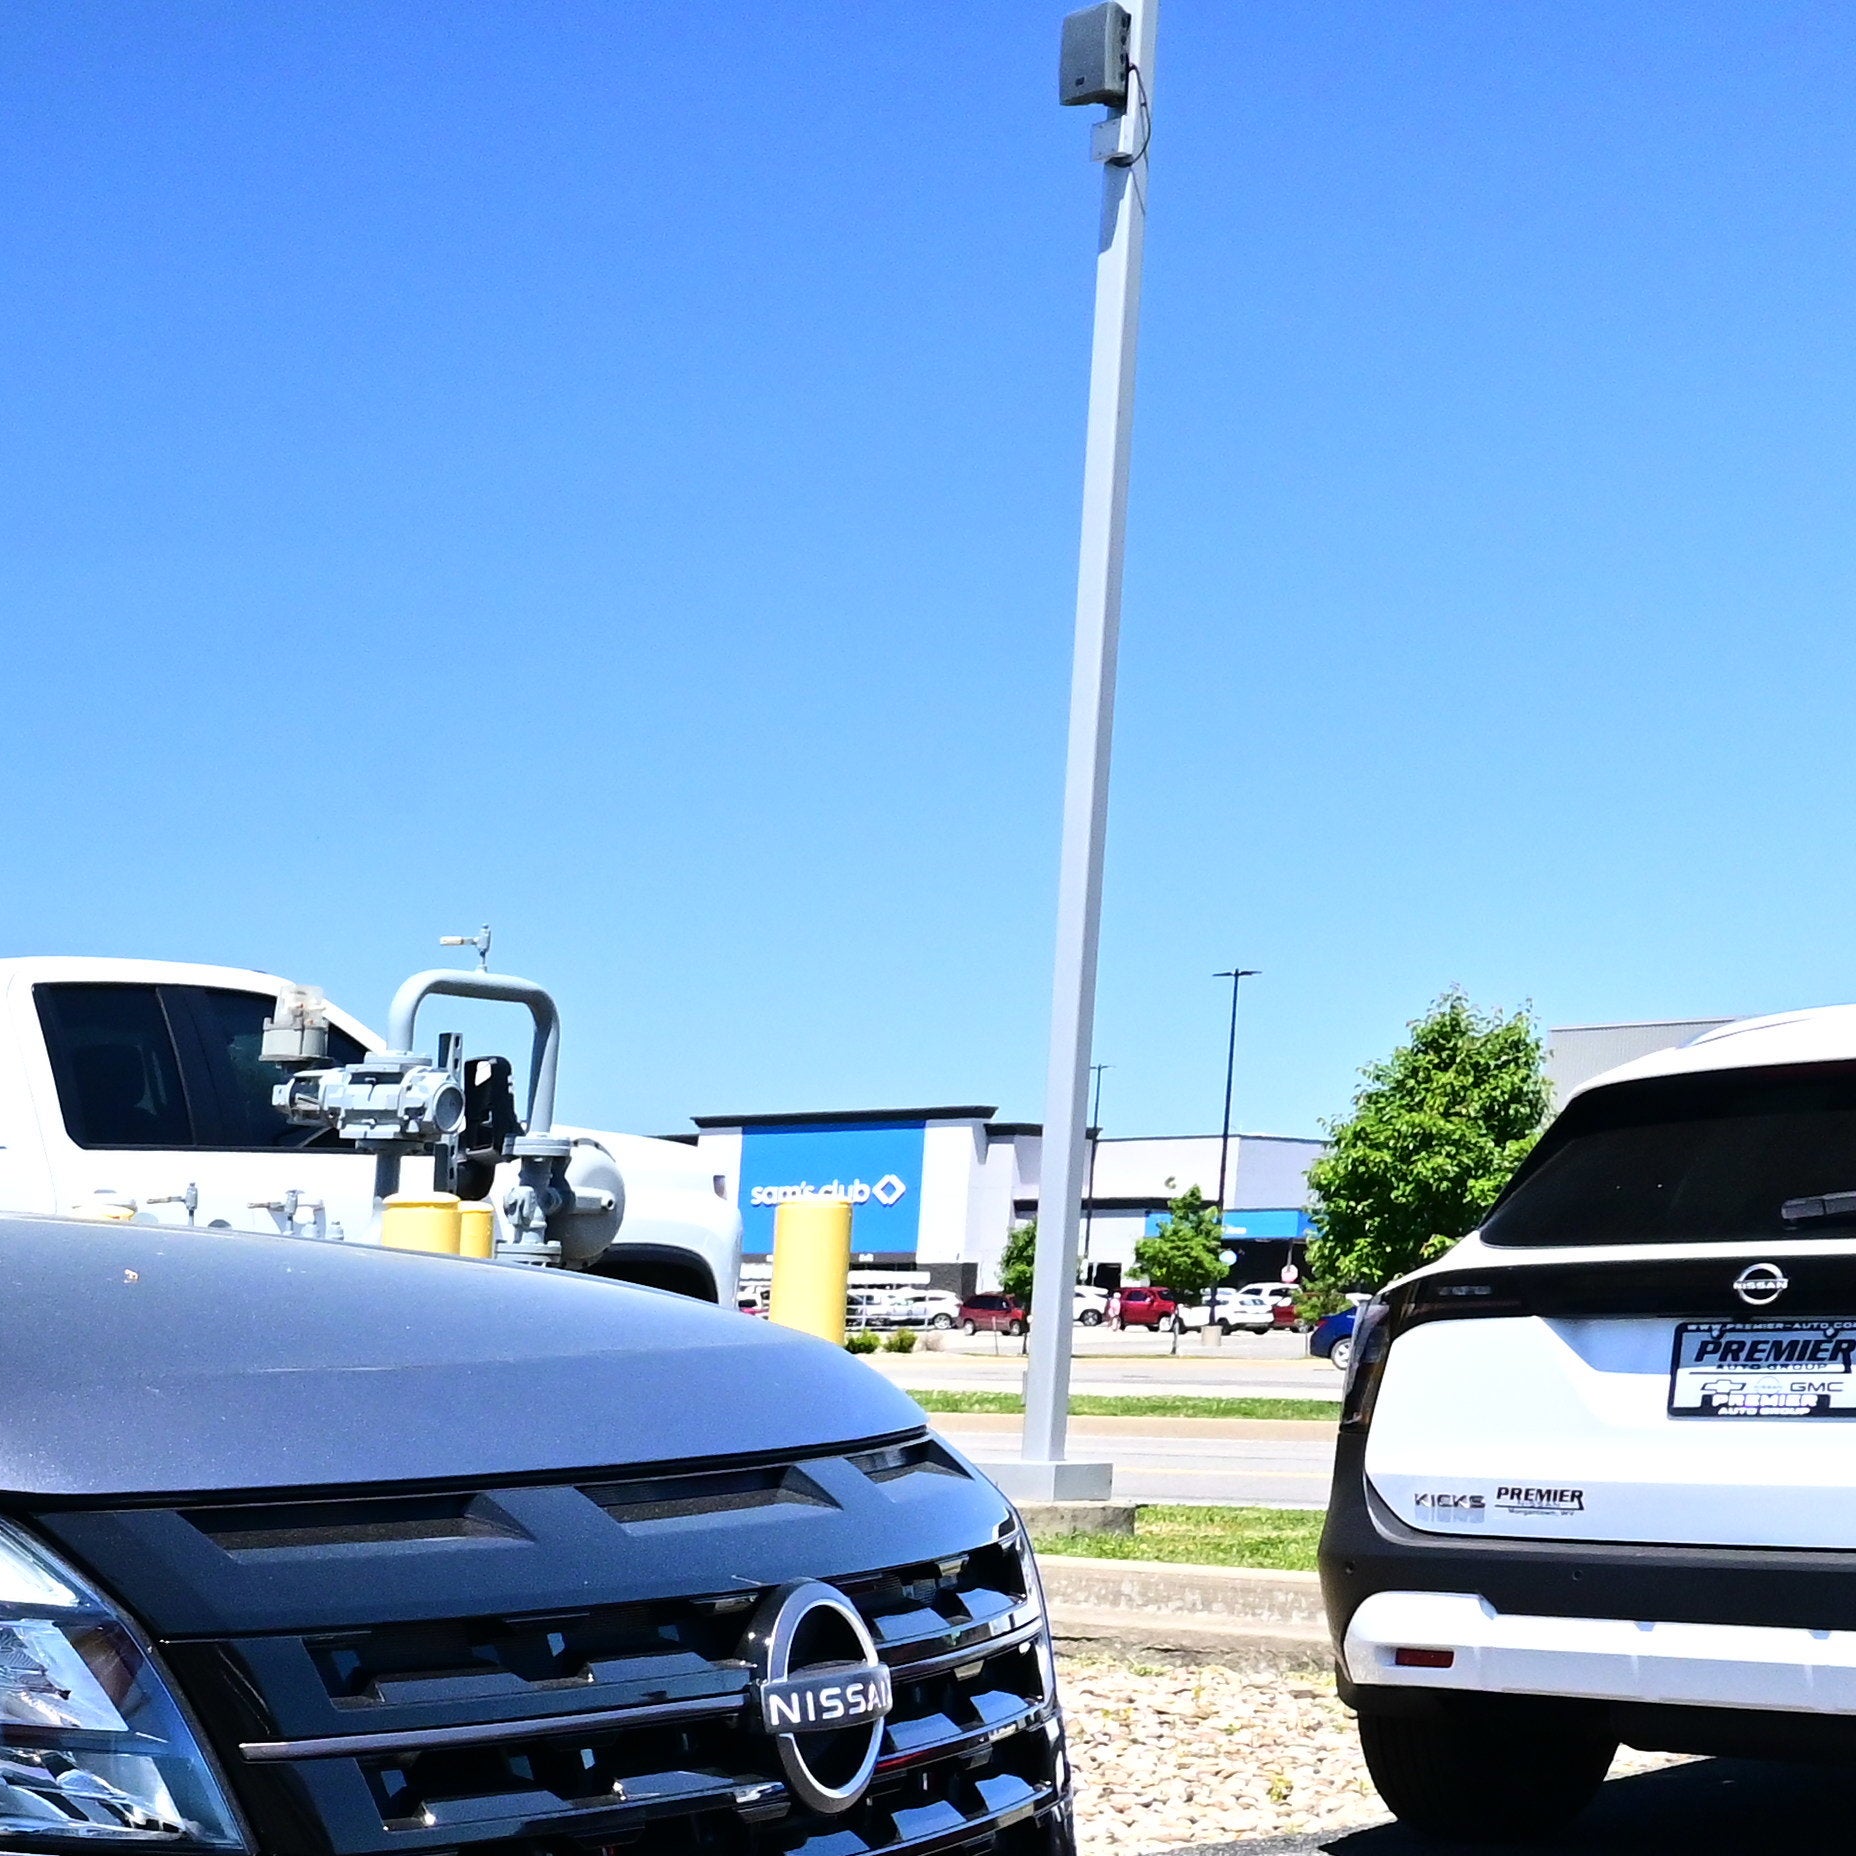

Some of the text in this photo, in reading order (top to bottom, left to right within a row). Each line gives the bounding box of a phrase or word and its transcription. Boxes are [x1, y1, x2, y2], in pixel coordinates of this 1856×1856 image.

[751, 1178, 871, 1206] sam's club
[1733, 1278, 1789, 1290] NISSAN
[1686, 1322, 1856, 1332] WWW.PREMIER-AUTO.CO
[1694, 1340, 1856, 1373] PREMIER
[1790, 1382, 1845, 1393] GMC
[1712, 1394, 1818, 1406] PREMIER
[1414, 1493, 1486, 1509] KICKS
[1496, 1487, 1585, 1510] PREMIER
[769, 1681, 893, 1727] NISSAN
